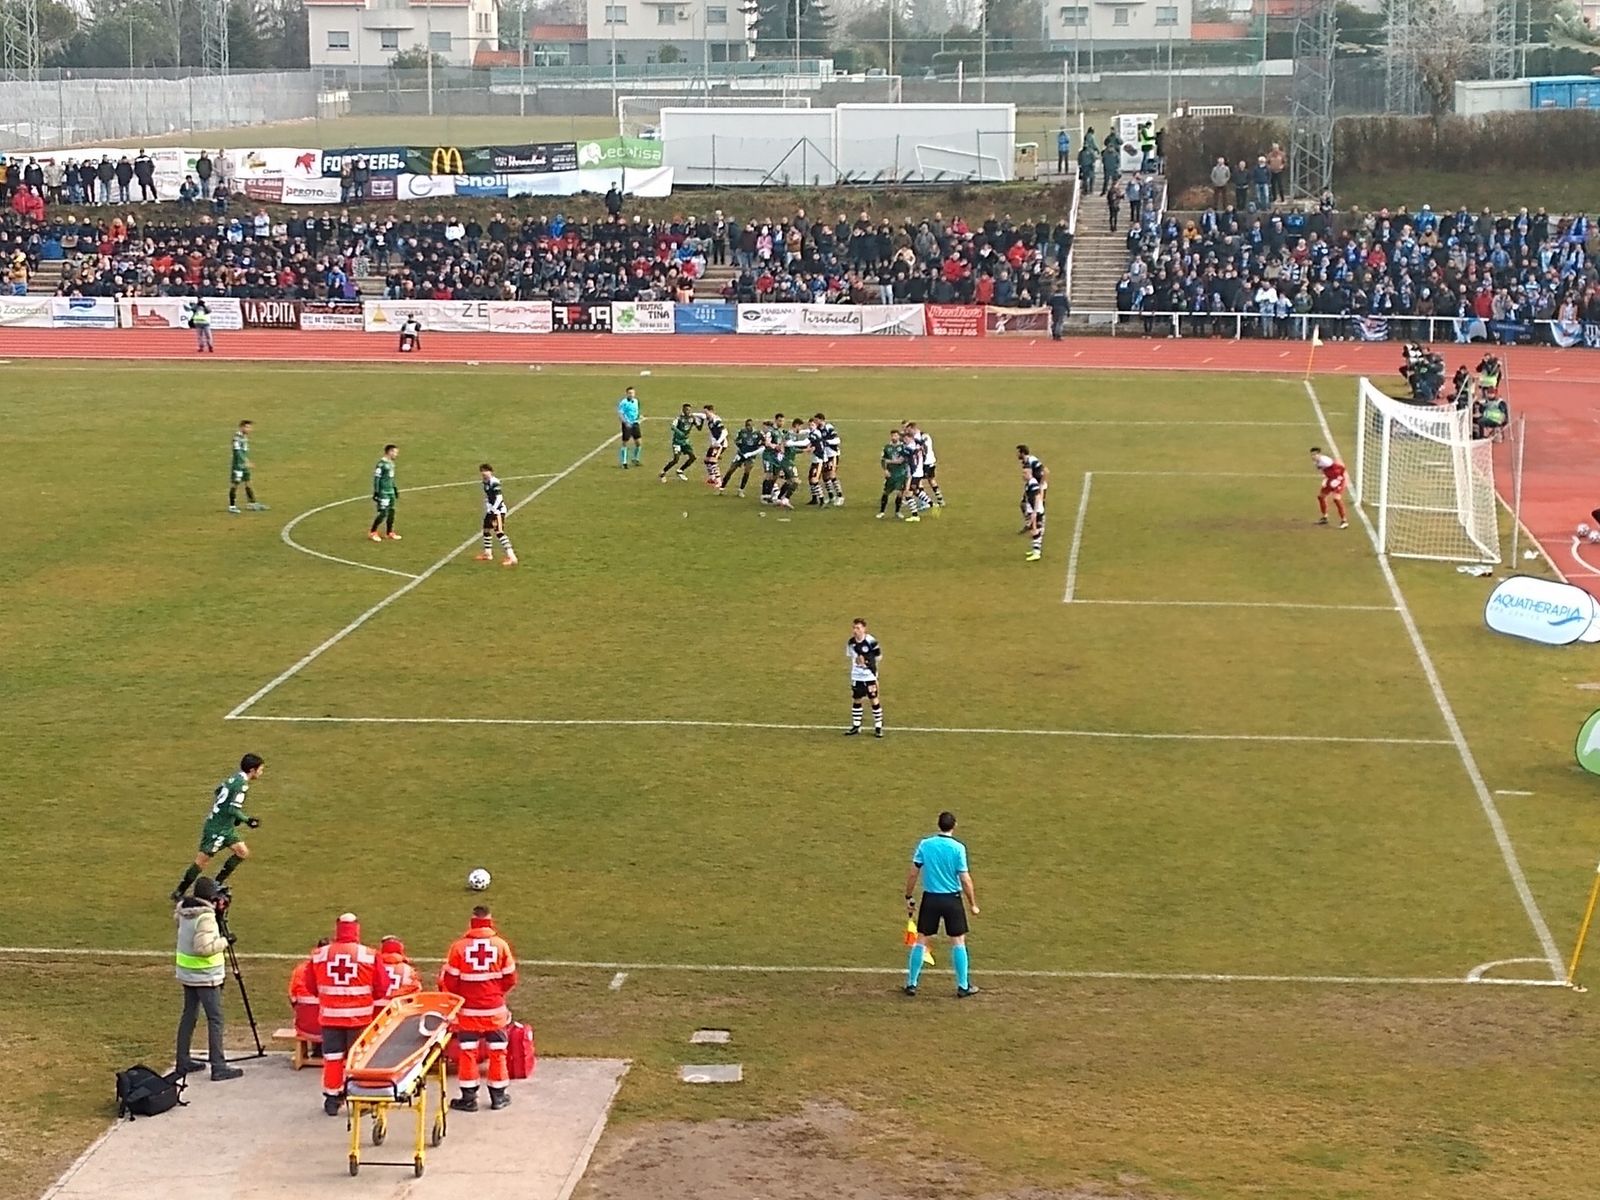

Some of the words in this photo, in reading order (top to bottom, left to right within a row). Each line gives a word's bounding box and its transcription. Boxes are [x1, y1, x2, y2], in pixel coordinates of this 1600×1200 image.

[260, 302, 296, 323] PEPITA
[648, 311, 669, 319] TINA
[1493, 593, 1582, 620] AQUATHERAPIA
